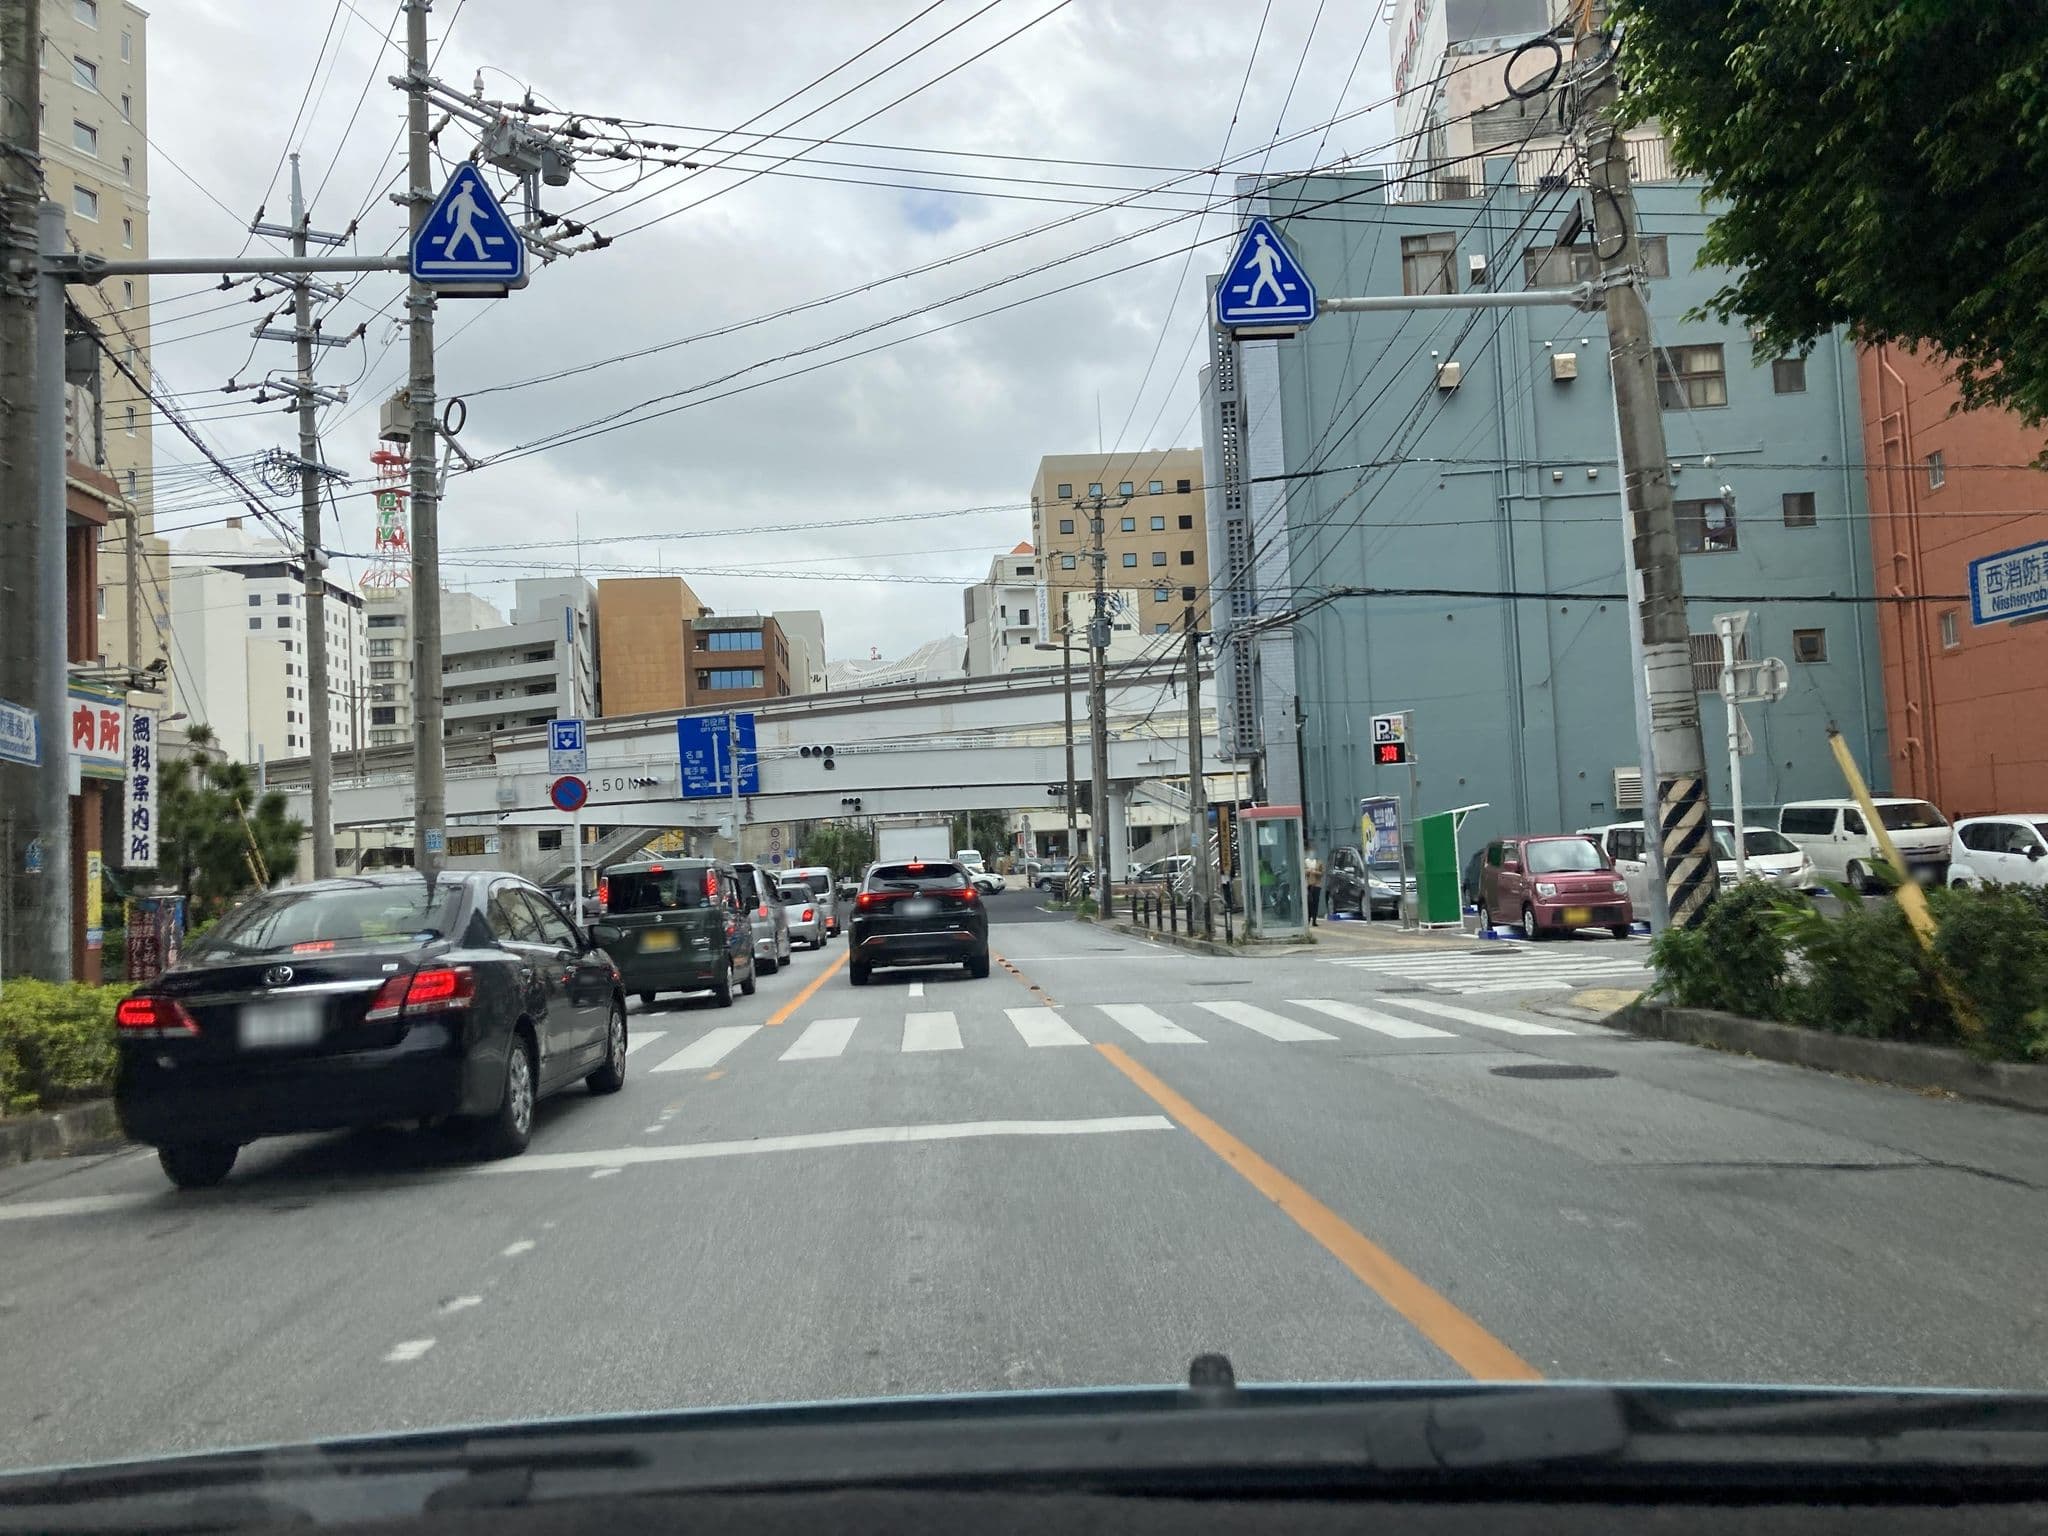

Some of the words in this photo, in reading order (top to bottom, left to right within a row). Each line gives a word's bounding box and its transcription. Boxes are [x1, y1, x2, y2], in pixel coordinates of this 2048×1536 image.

[1376, 721, 1389, 740] P
[1381, 746, 1397, 761] 満
[130, 714, 151, 861] 無料案内所
